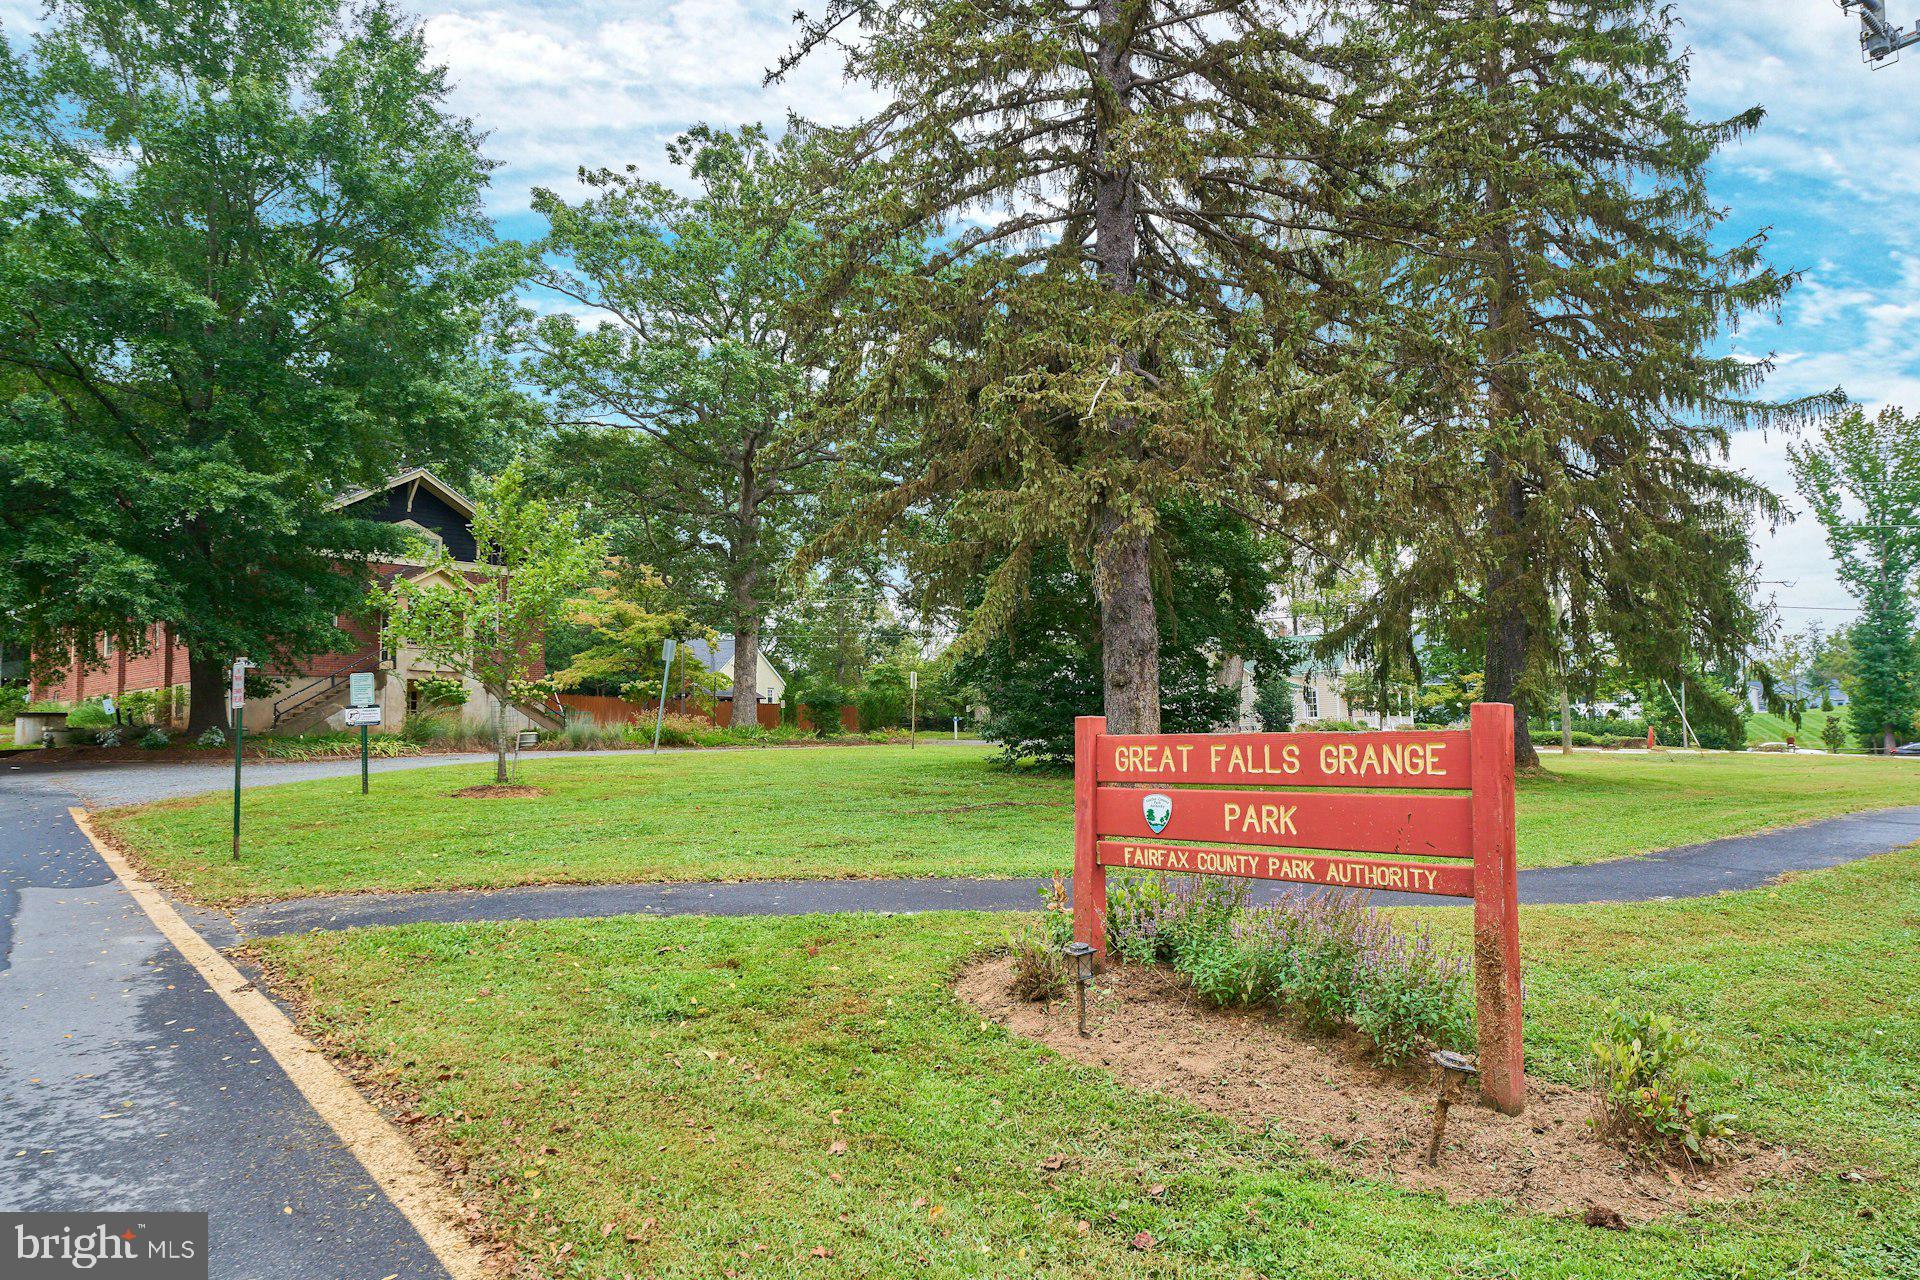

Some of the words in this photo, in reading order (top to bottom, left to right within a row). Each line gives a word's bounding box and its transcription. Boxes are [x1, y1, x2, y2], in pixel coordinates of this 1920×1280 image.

[1115, 744, 1194, 773] GREAT
[1210, 743, 1300, 774] FALLS
[1319, 742, 1447, 776] GRANGE
[1224, 802, 1298, 835] PARK
[1124, 847, 1190, 869] FAIRFAX
[1197, 852, 1259, 875] COUNTY
[1268, 857, 1316, 880] PARK
[1326, 862, 1438, 890] AUTHORITY
